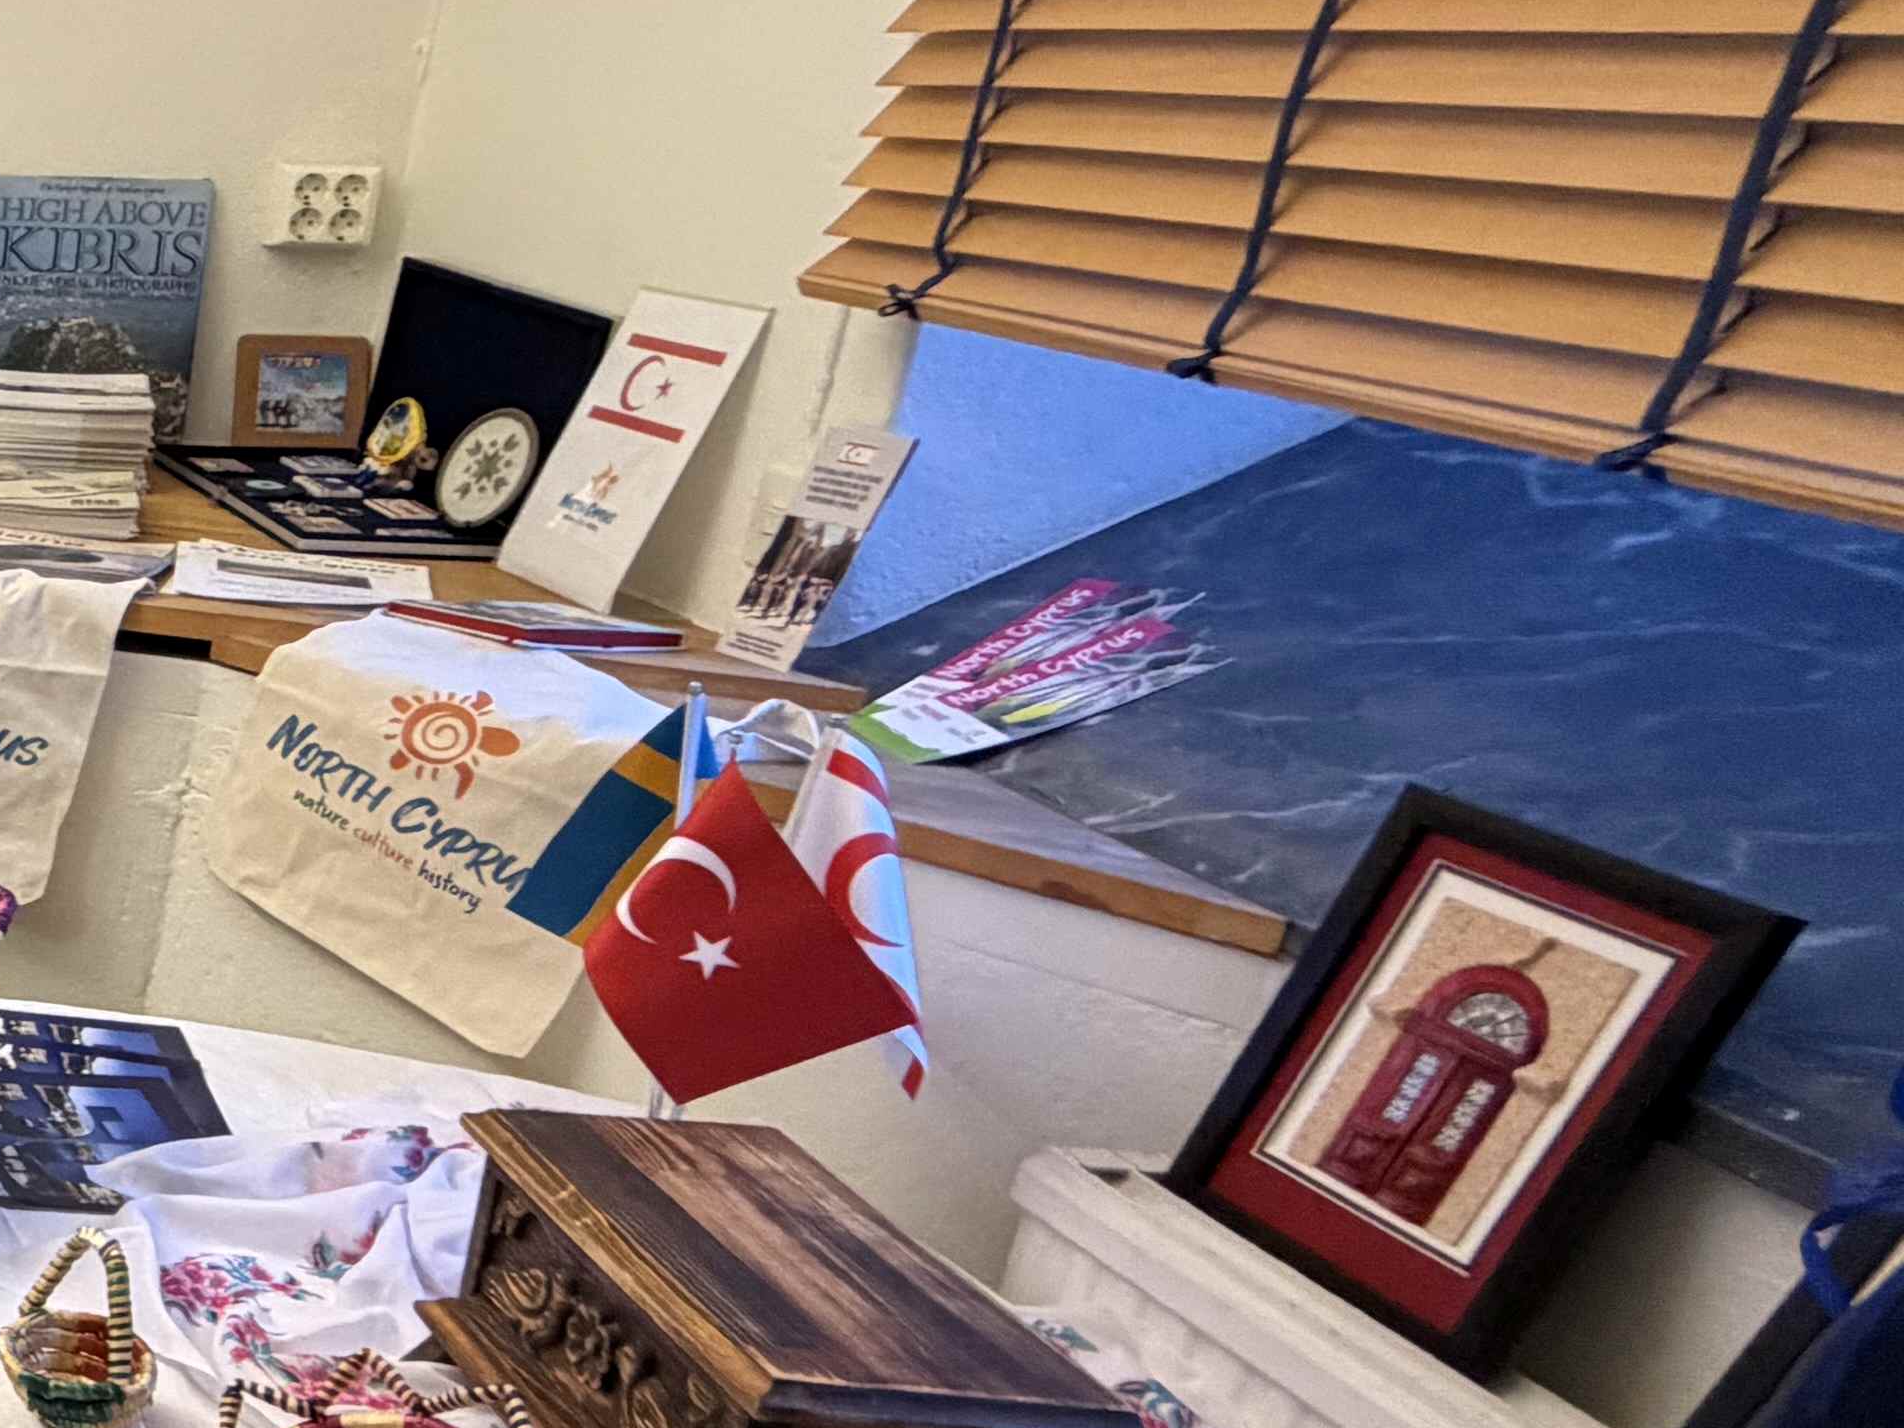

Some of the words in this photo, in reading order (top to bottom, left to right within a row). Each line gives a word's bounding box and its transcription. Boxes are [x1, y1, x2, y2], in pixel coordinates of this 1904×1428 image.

[2, 197, 91, 222] HIGH
[93, 199, 206, 227] ABOVE
[936, 629, 1012, 680] North
[947, 670, 1039, 709] North
[266, 714, 393, 813] NORTH
[390, 797, 528, 892] CYPRU
[293, 787, 349, 831] nature
[352, 825, 413, 871] culture
[417, 858, 482, 914] history
